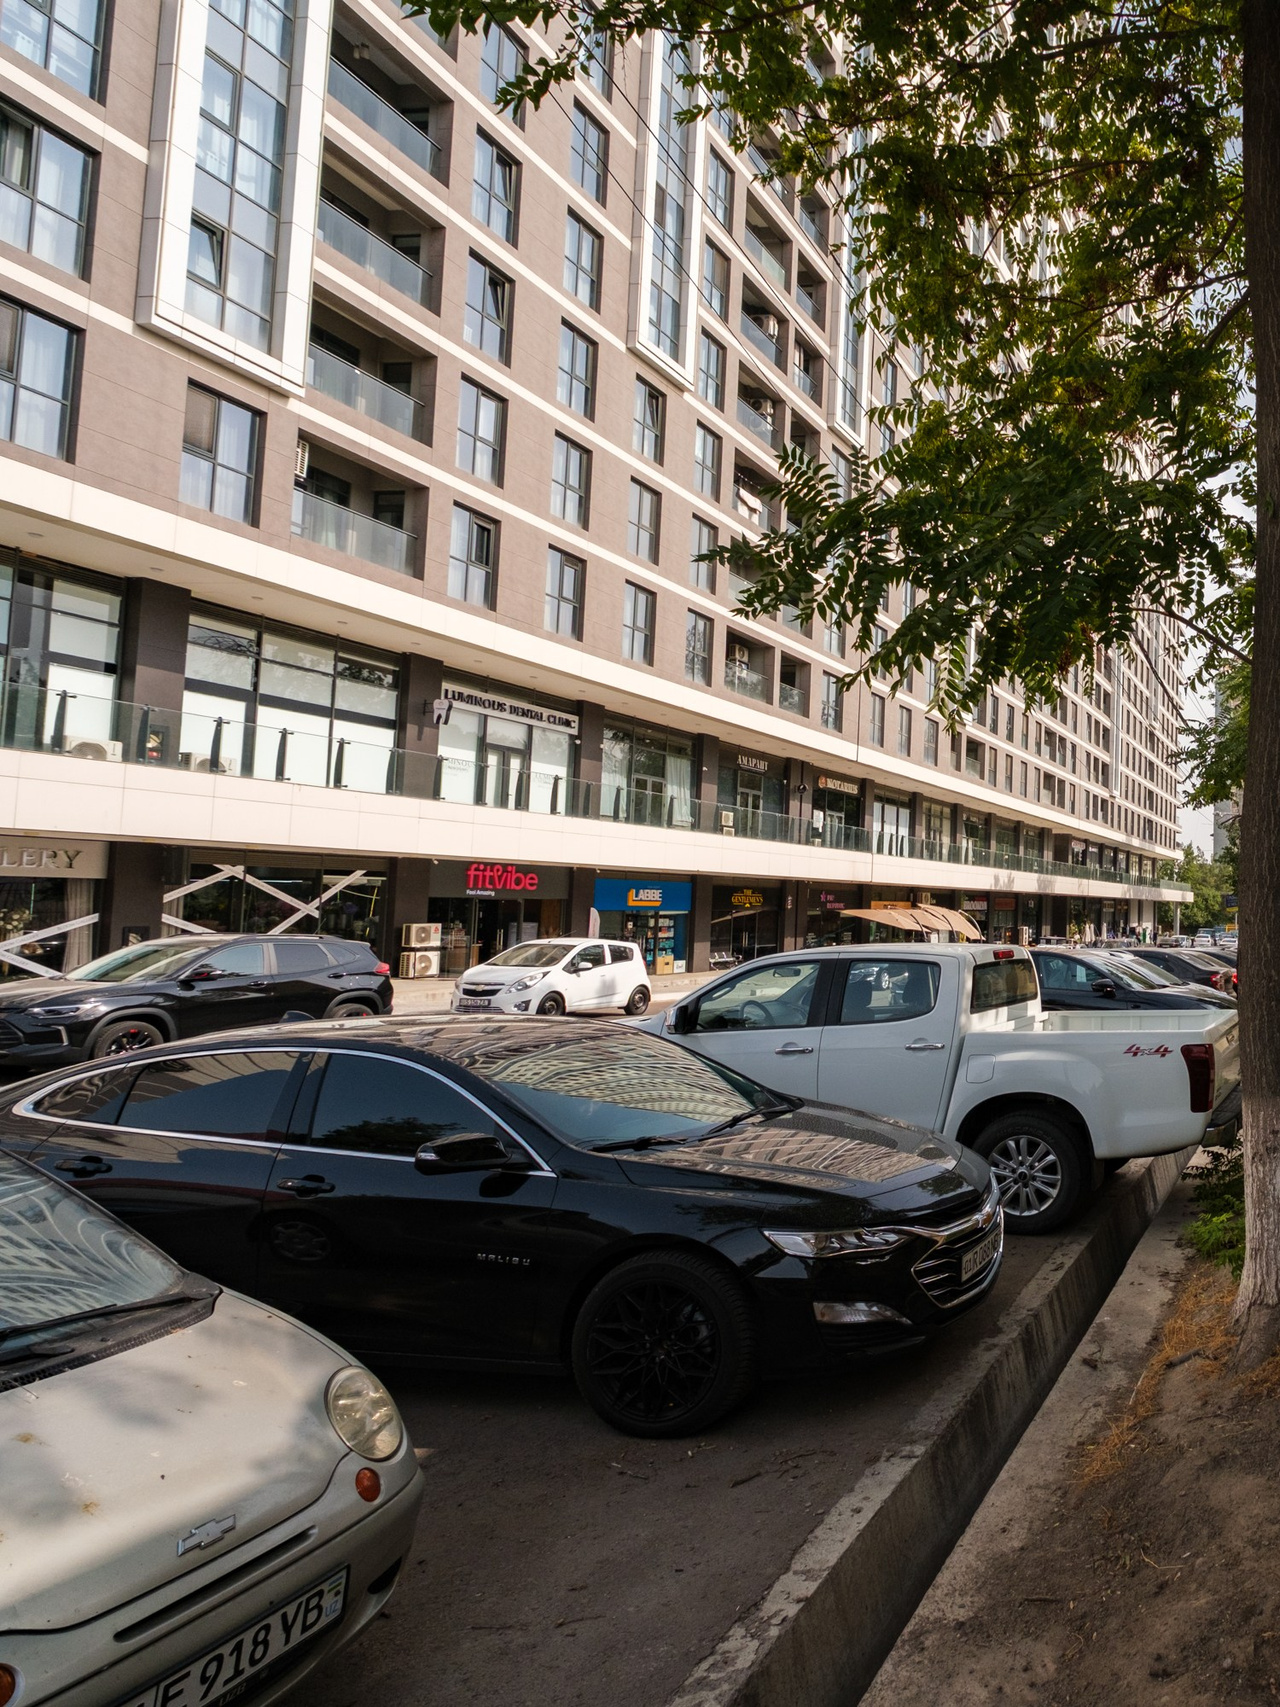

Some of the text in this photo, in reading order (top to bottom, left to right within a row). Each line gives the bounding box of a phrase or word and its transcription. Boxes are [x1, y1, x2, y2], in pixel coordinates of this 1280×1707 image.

[444, 688, 576, 729] LUMINOUS DENTAL CLINIC
[466, 864, 538, 891] fitvibe
[632, 889, 662, 901] LABBE
[477, 1253, 530, 1266] MALIBU
[325, 1599, 340, 1618] UZ
[200, 1622, 271, 1702] 918
[281, 1588, 325, 1647] YB
